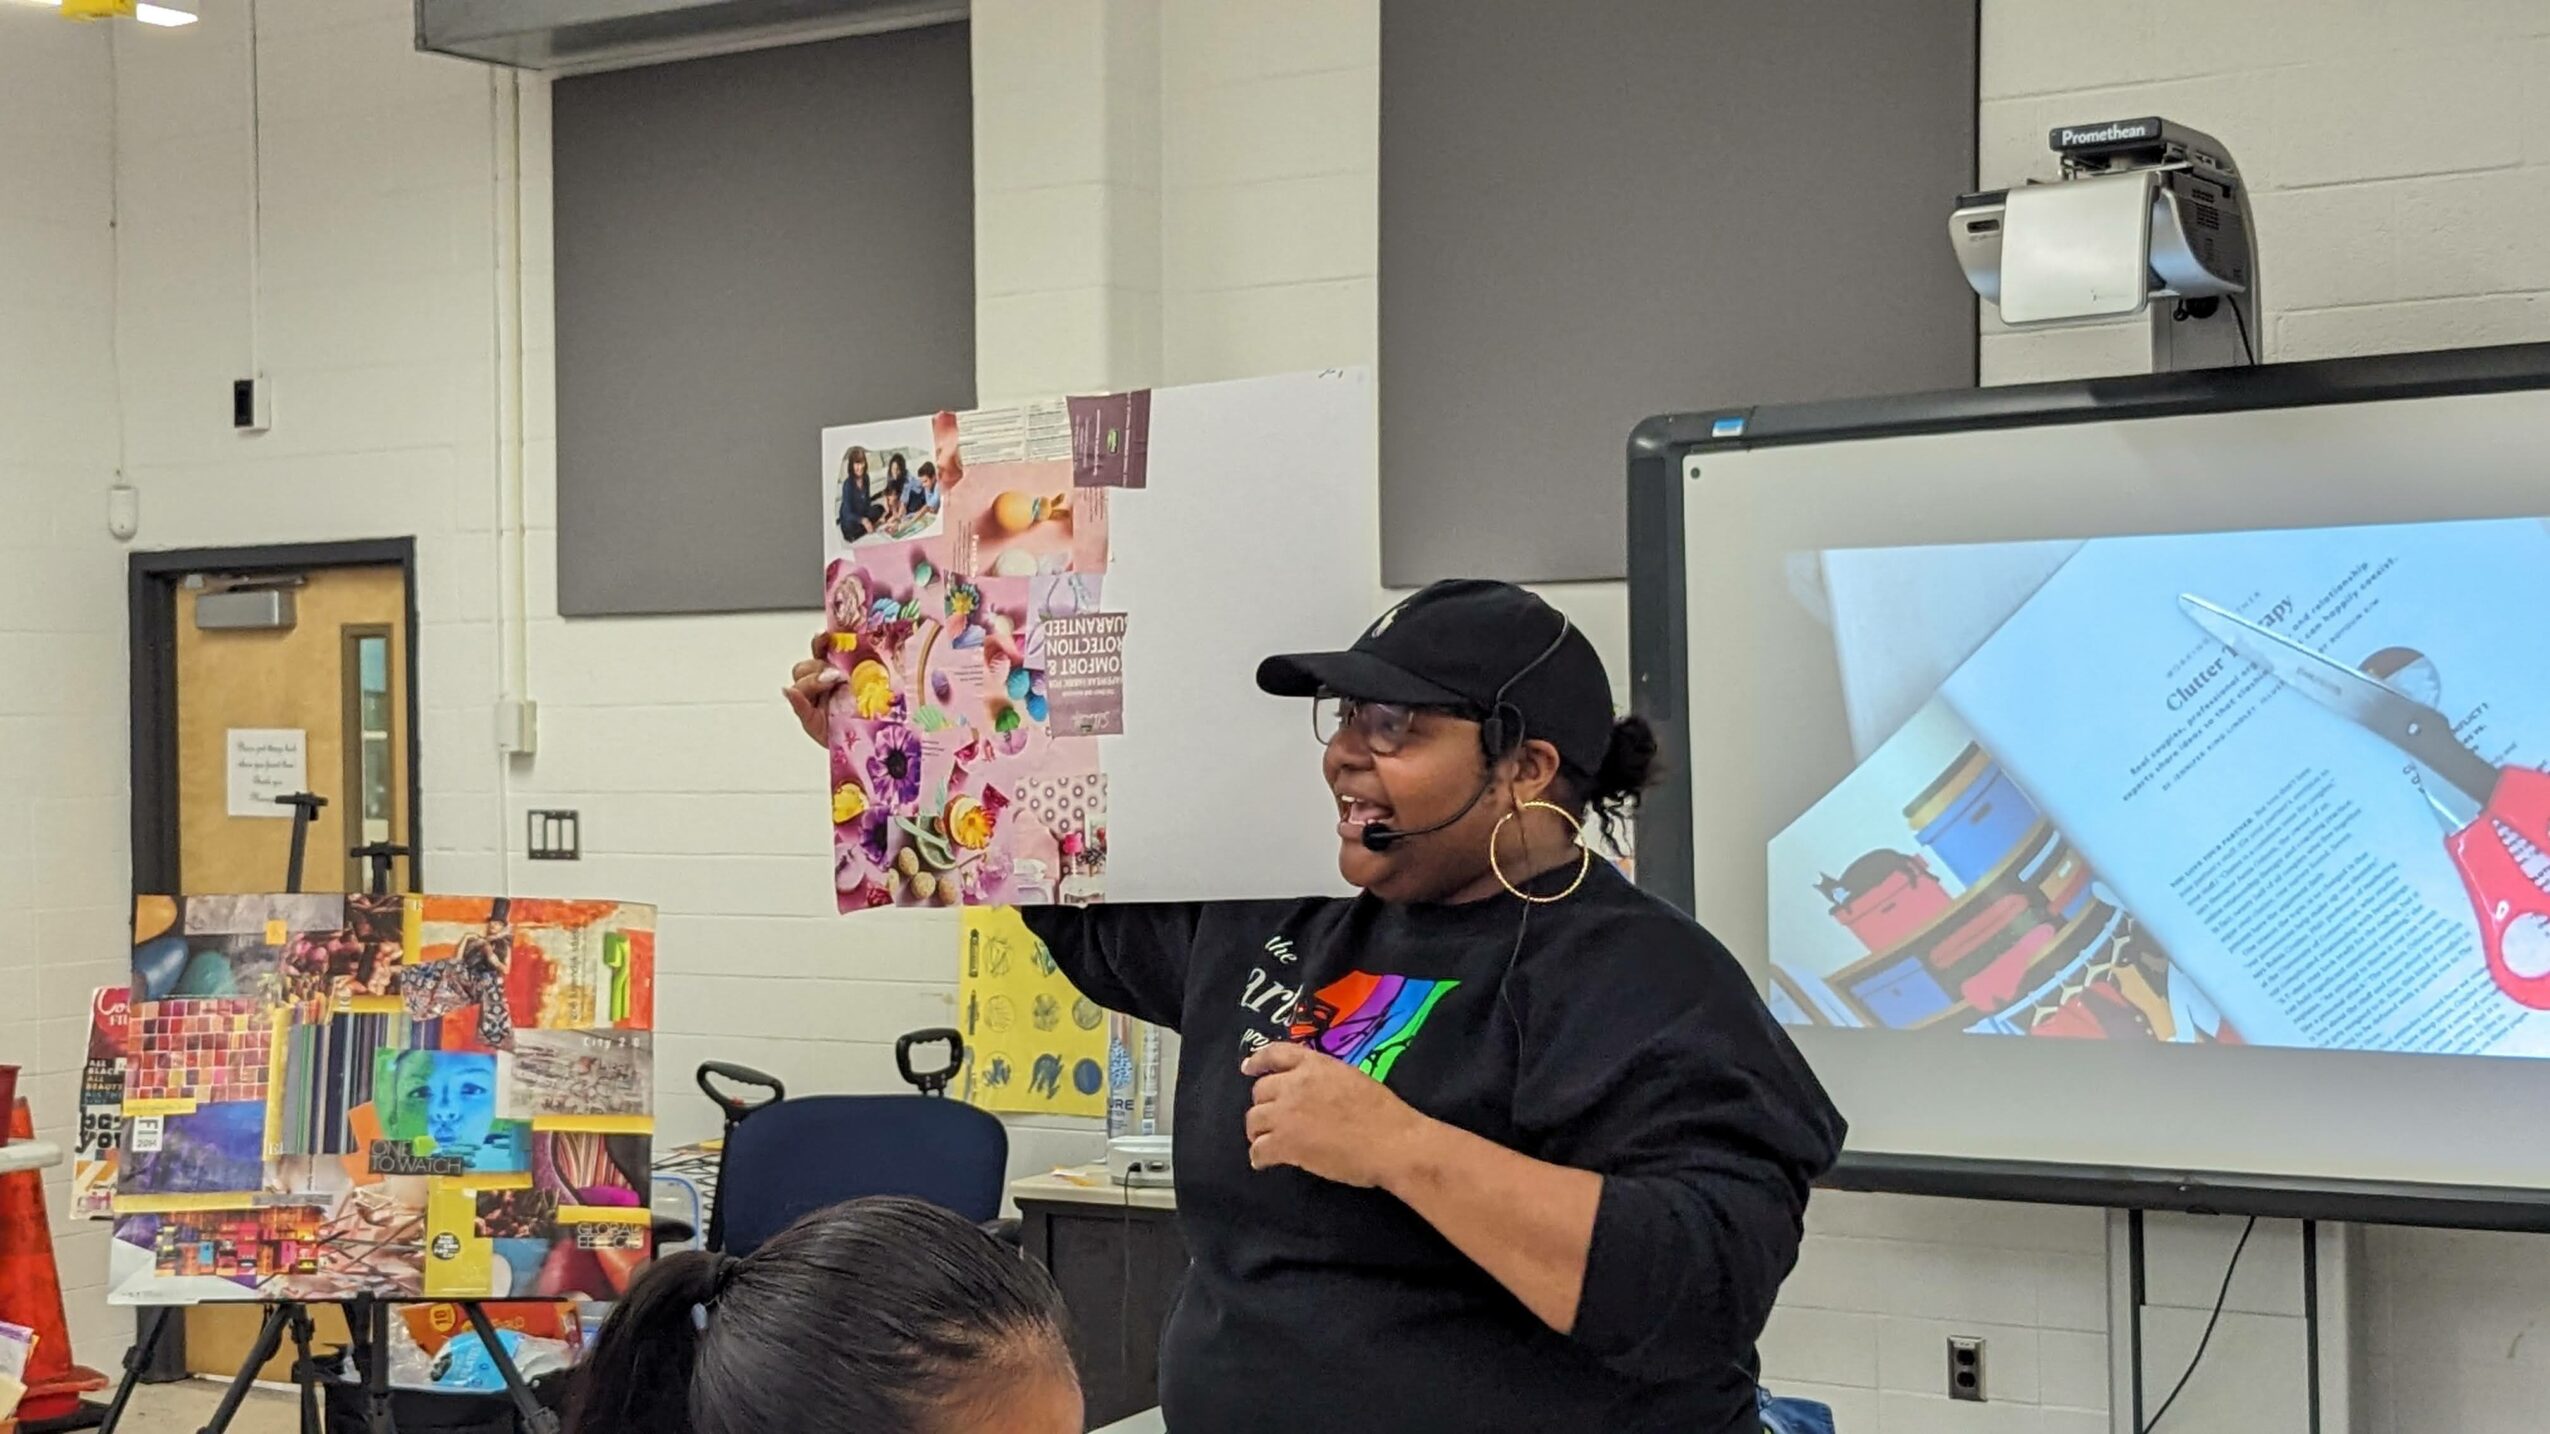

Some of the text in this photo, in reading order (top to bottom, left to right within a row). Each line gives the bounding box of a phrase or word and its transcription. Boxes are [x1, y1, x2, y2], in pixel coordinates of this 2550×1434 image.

[2062, 124, 2145, 145] Promethean
[2292, 613, 2310, 632] and
[2311, 561, 2369, 614] relationship
[1044, 616, 1126, 636] UARANTEED
[2166, 656, 2225, 711] Clutter
[2221, 595, 2295, 658] Trapy
[2215, 698, 2237, 718] that
[2323, 589, 2359, 623] happily
[1047, 656, 1122, 676] OMFORT &
[1265, 936, 1297, 964] the
[371, 1155, 461, 1174] TO WATCH
[577, 1223, 642, 1236] GLOBAL
